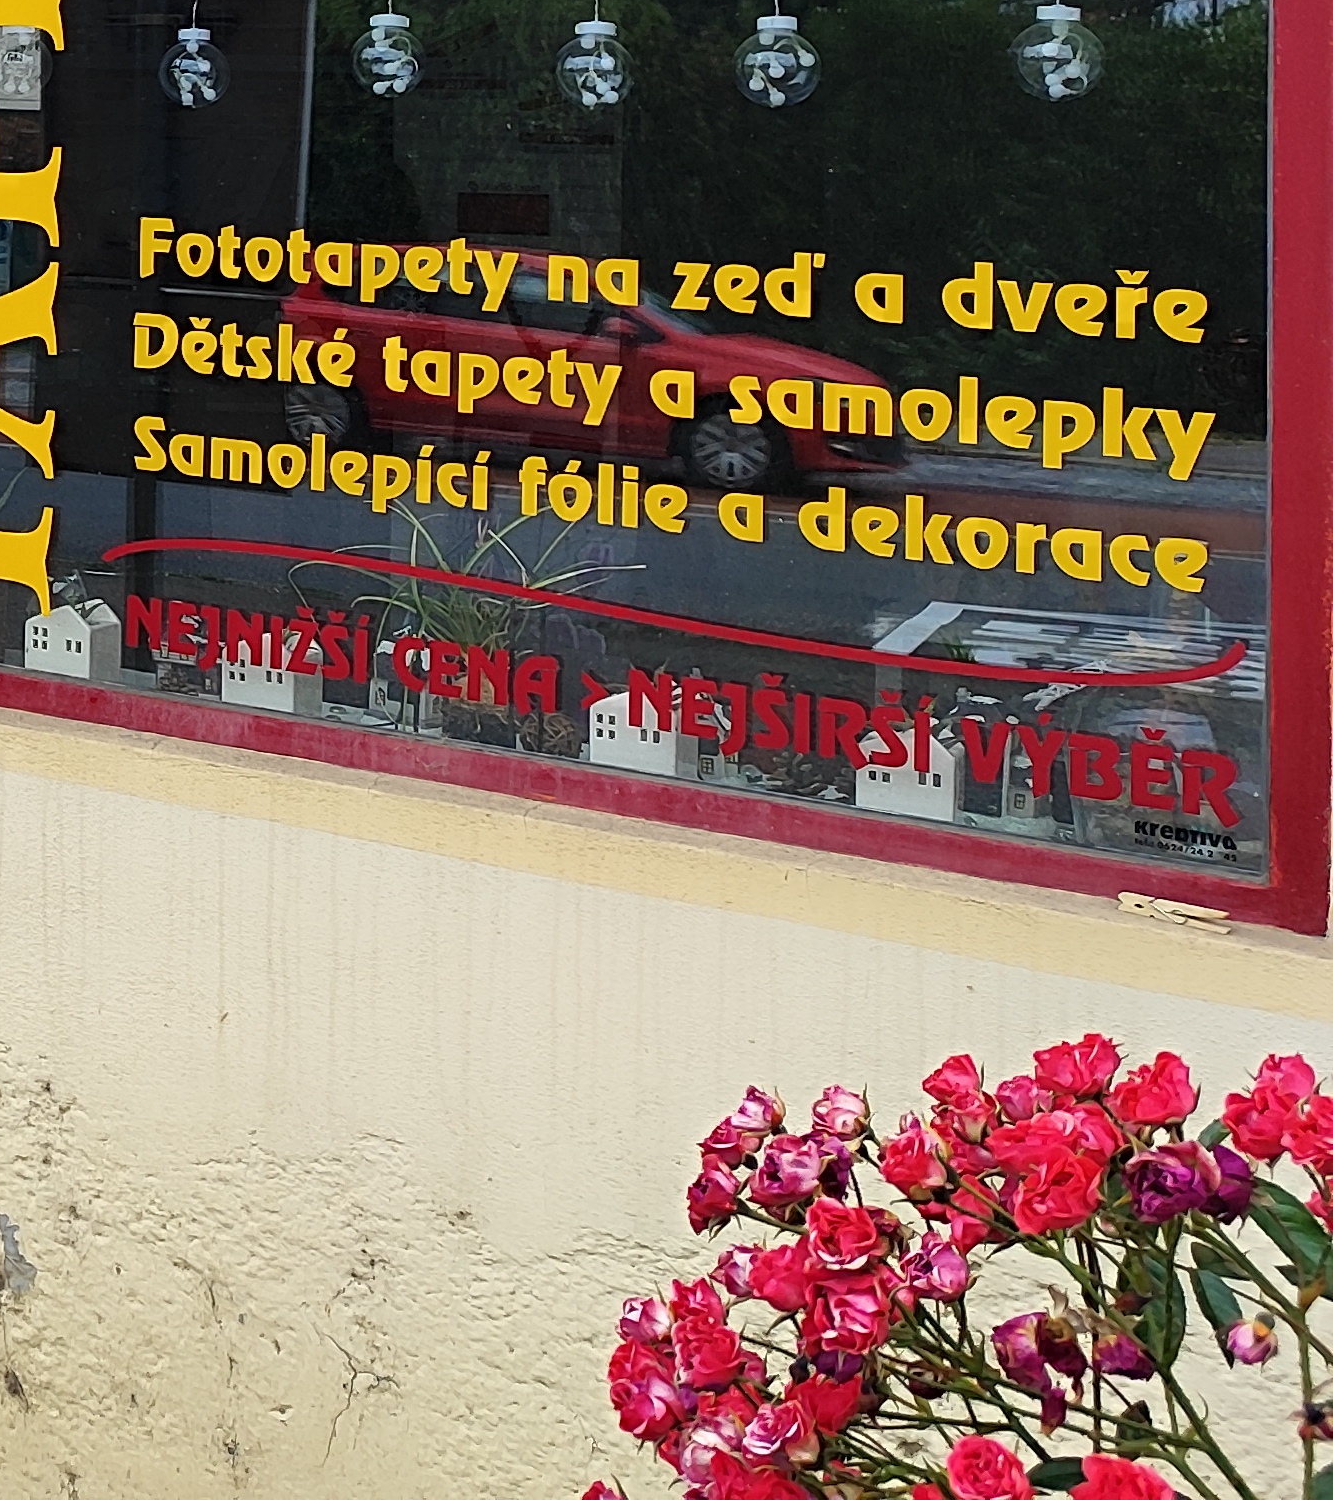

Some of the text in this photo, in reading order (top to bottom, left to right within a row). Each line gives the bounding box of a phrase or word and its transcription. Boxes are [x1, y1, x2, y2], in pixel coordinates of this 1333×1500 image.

[138, 217, 1209, 344] Fototapety na zeď a dveře
[133, 312, 1217, 482] Dětské tapety a samolepky
[133, 415, 1209, 593] Samolepící fólie a dekorace
[125, 594, 371, 685] NEJNIŽŠÍ
[392, 636, 560, 717] CENA
[627, 667, 934, 774] NEJŠIRŠÍ
[959, 711, 1241, 828] VÝBĚR
